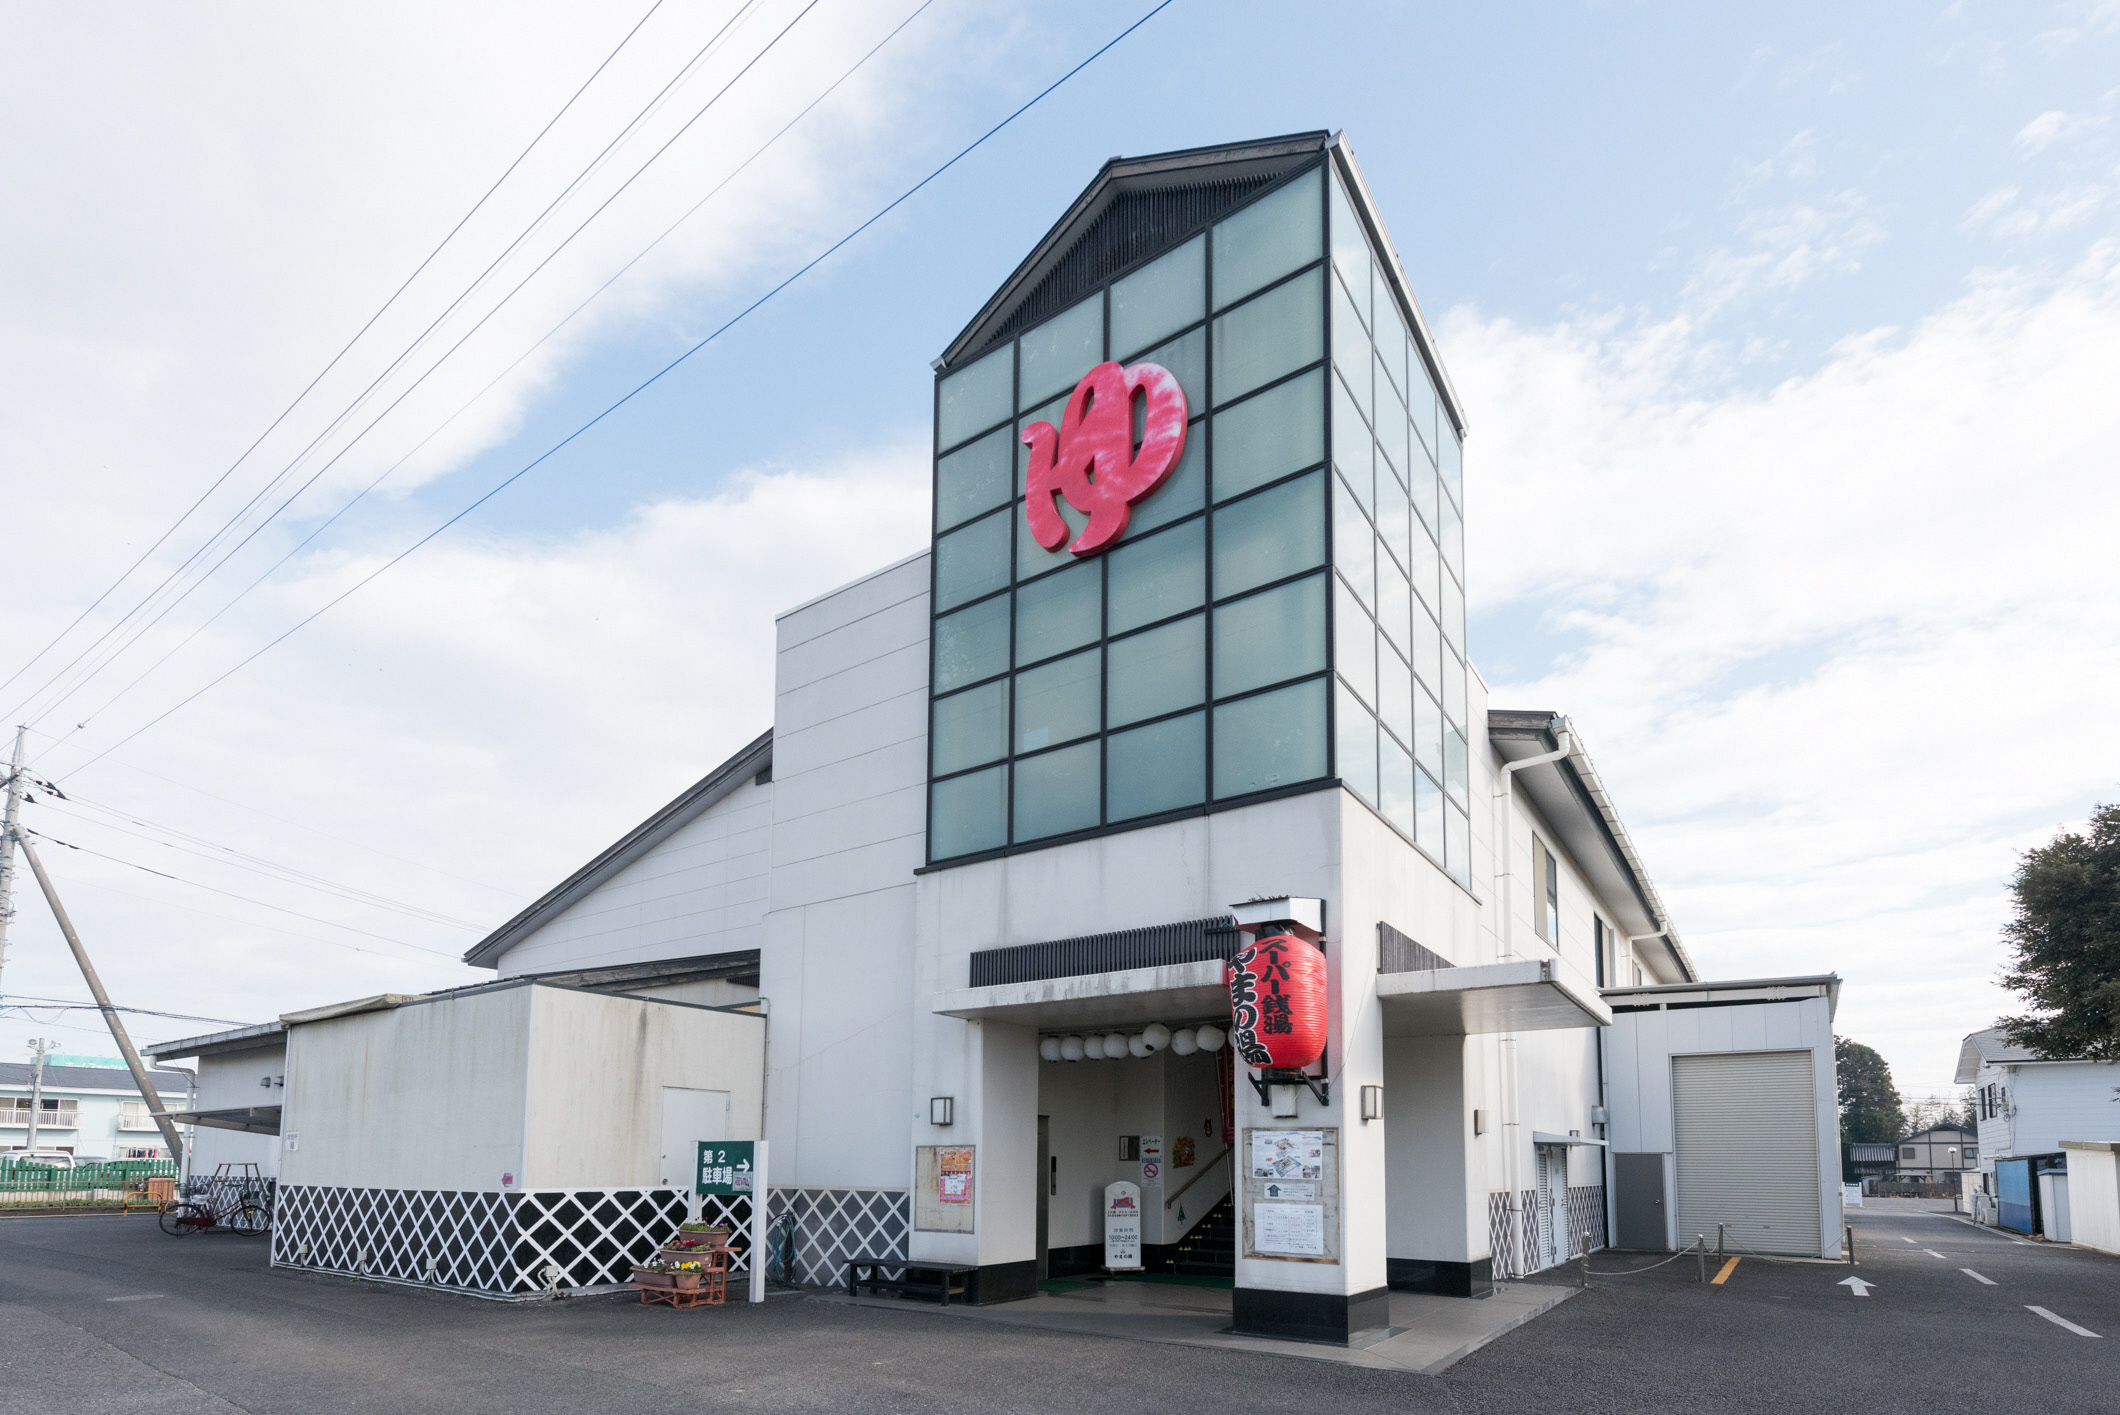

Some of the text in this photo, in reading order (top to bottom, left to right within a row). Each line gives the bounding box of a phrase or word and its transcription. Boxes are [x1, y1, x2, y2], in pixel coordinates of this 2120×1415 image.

[1021, 361, 1188, 558] ゆ
[1228, 947, 1273, 1066] やまの湯
[1259, 938, 1293, 1035] スーパー銭湯
[701, 1166, 733, 1185] 駐車場
